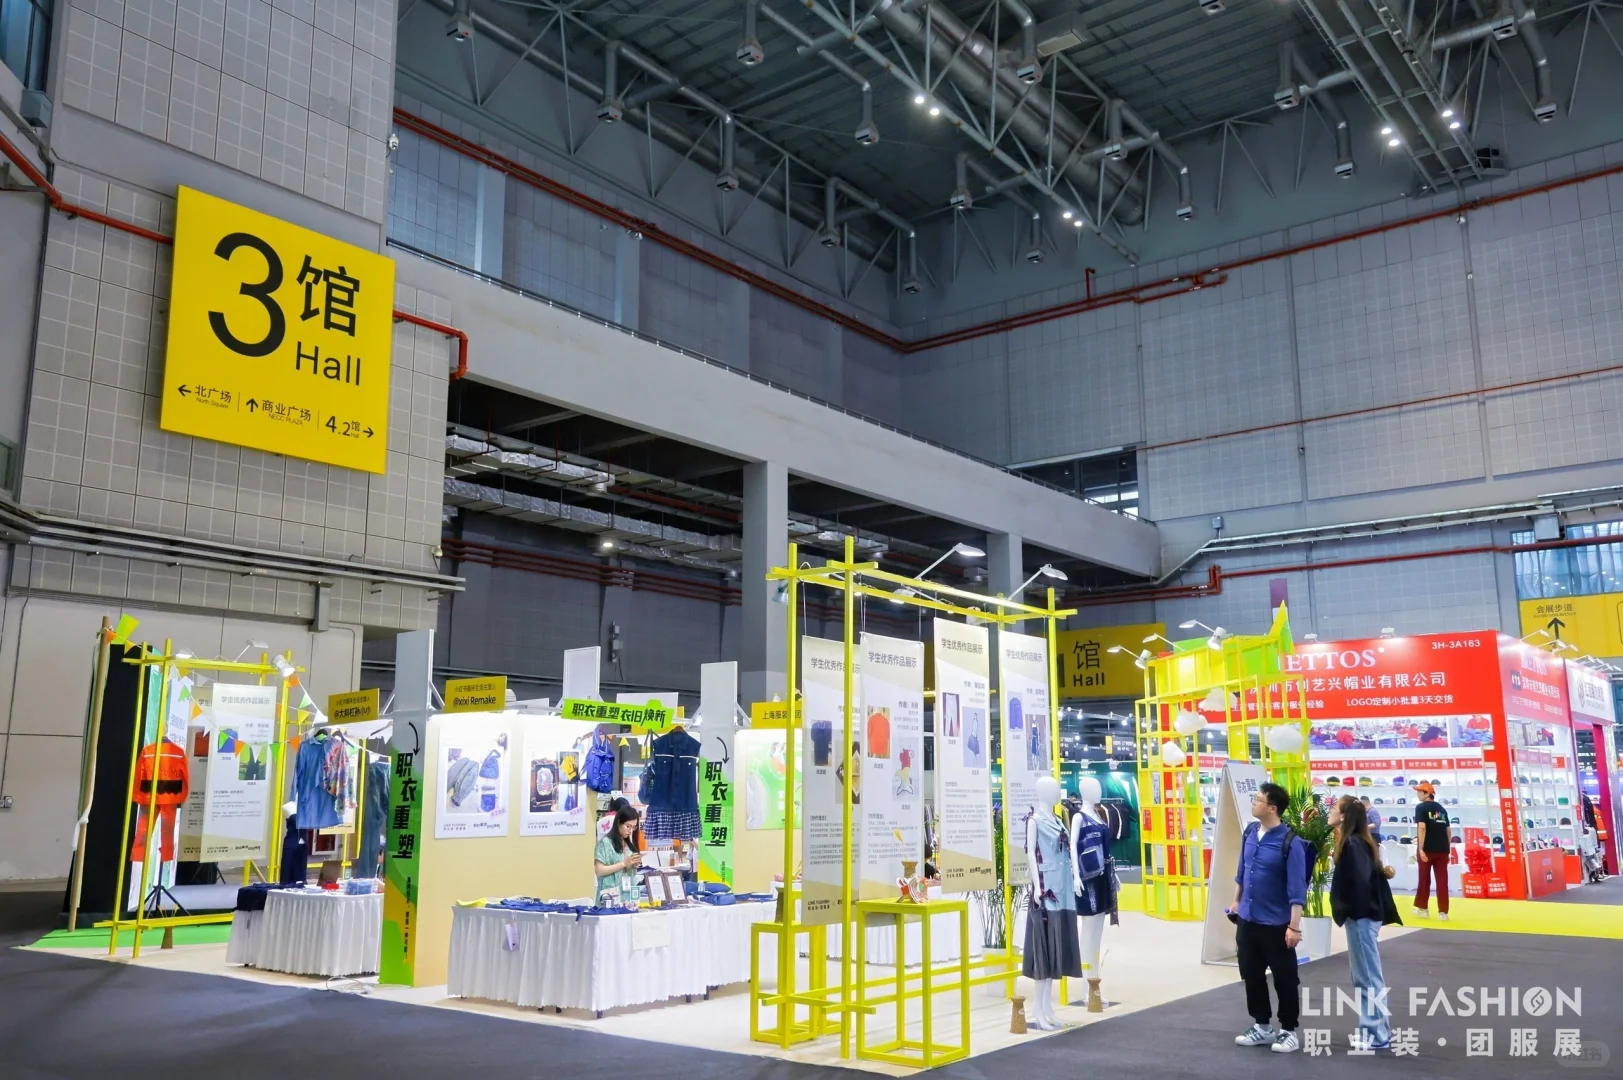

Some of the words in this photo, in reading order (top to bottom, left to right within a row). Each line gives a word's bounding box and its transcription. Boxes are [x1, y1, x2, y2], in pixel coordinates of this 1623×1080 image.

[208, 232, 286, 357] 3
[296, 254, 360, 337] 馆
[295, 341, 361, 386] Hall
[195, 385, 232, 403] 北广场
[210, 399, 229, 409] Square
[261, 399, 312, 422] 商业广场
[286, 416, 304, 426] PLAZA
[1536, 603, 1573, 613] 会展步道
[941, 637, 983, 655] 学生优秀作品展示
[1431, 639, 1481, 650] 3H-3A163
[868, 650, 918, 668] 学生优秀作品展示
[1005, 649, 1043, 663] 学生优秀作品展示
[1073, 640, 1100, 670] 馆
[1278, 649, 1376, 672] ETTOS
[810, 657, 860, 674] 学生优秀作示
[1073, 673, 1105, 687] Hall
[220, 696, 270, 704] 学生优秀作品展示
[470, 694, 496, 706] Remake
[1346, 694, 1454, 707] LOGO定制小批量3天交货
[762, 709, 802, 720] 上海服装团
[1408, 760, 1438, 768] 创艺兴帽业
[392, 752, 418, 859] 职衣重塑
[704, 761, 728, 847] 职衣重塑
